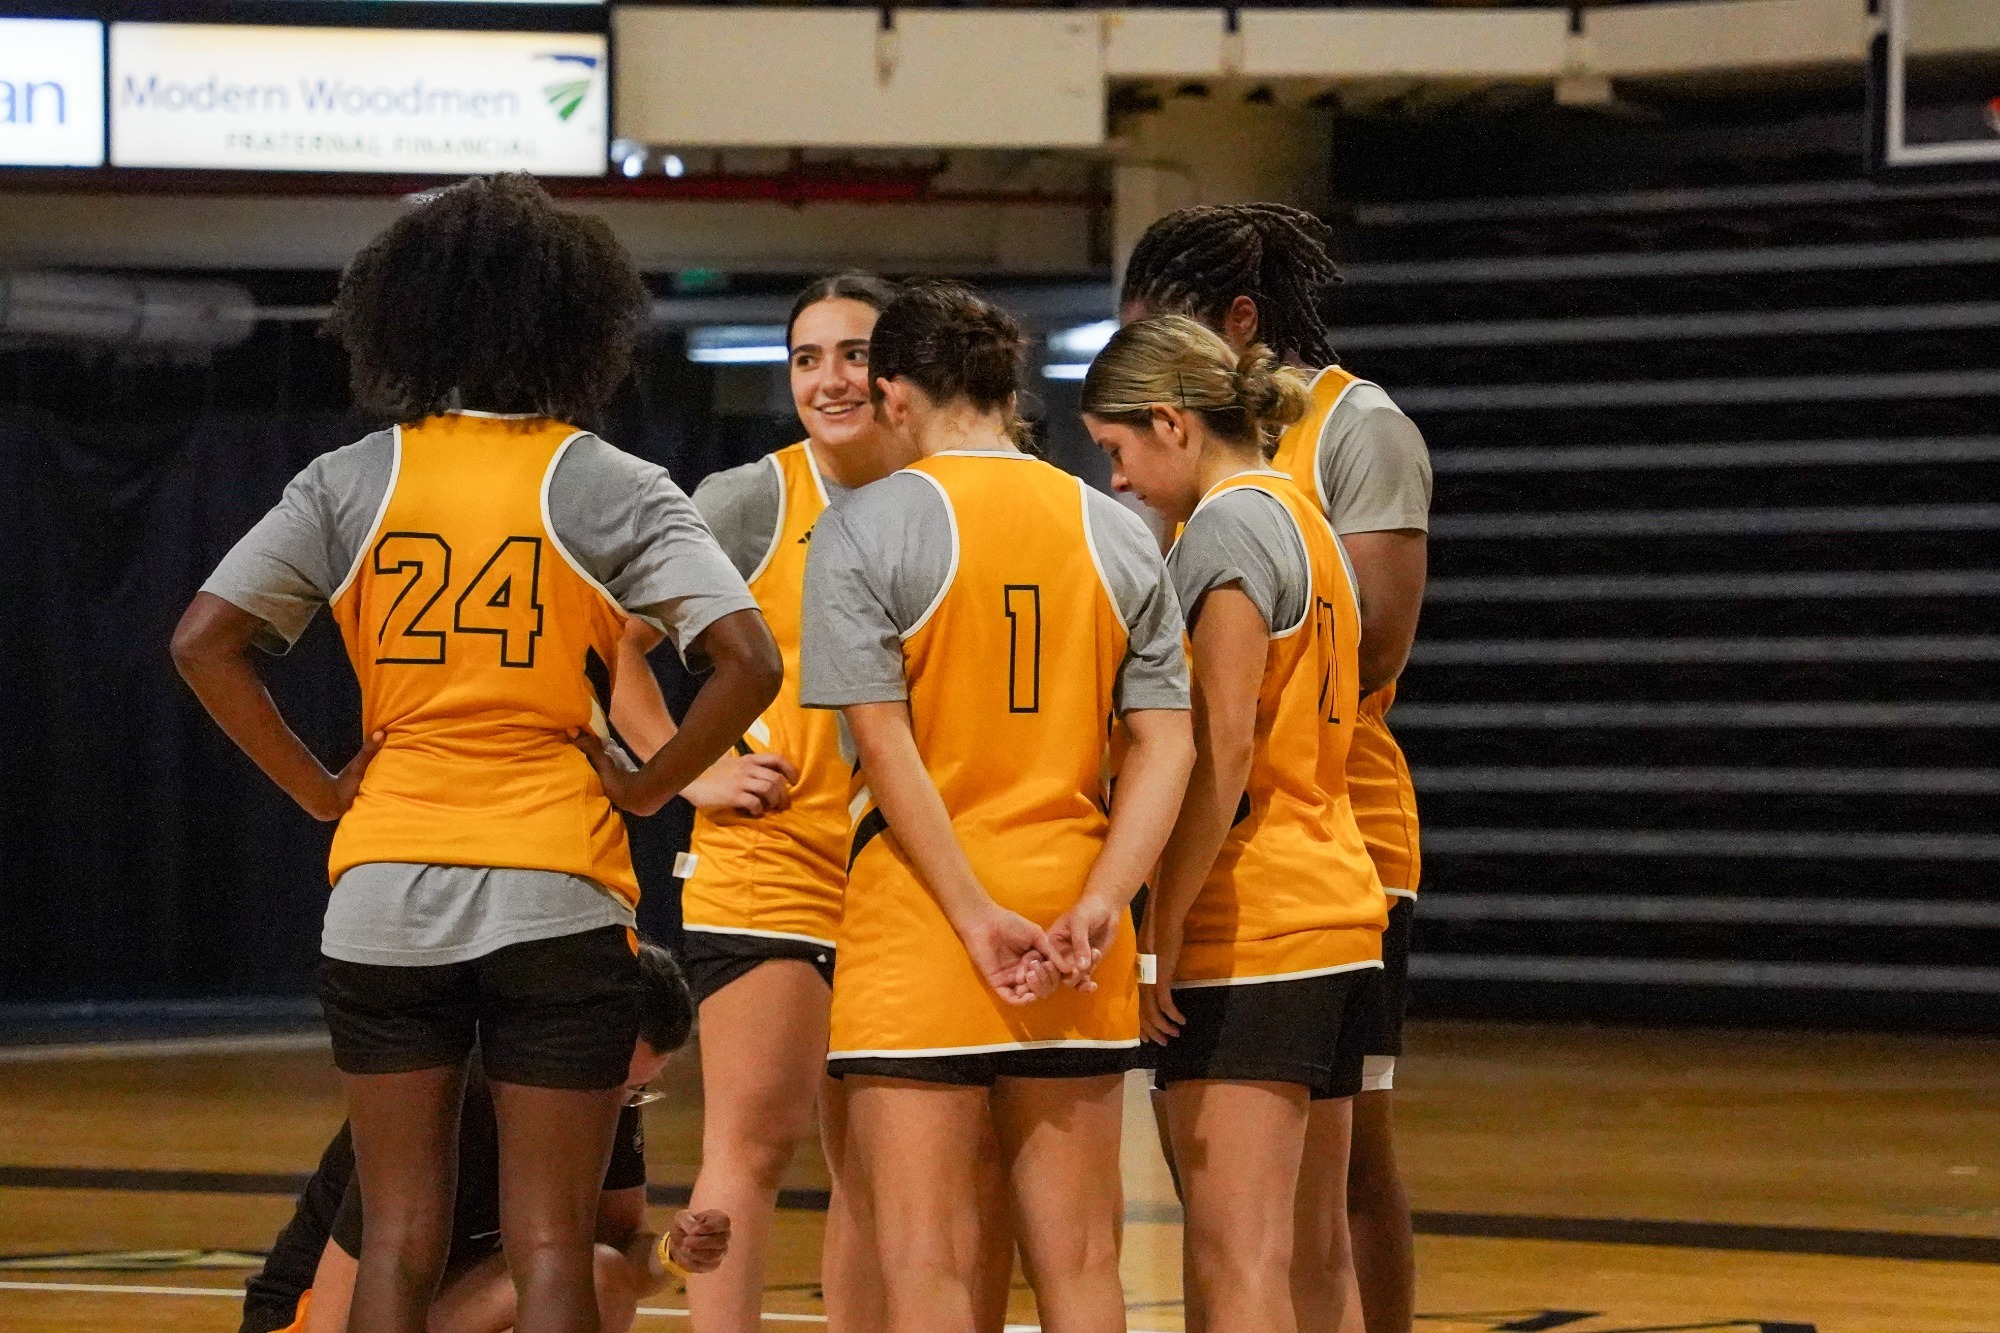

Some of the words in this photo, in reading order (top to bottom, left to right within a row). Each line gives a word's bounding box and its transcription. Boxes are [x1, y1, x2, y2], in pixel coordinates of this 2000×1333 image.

[121, 72, 290, 113] Modern
[298, 76, 519, 118] Woodmen
[223, 130, 379, 156] FRATERNAL
[392, 133, 541, 159] FINANCIAL
[374, 532, 544, 668] 24
[1004, 584, 1041, 713] 1
